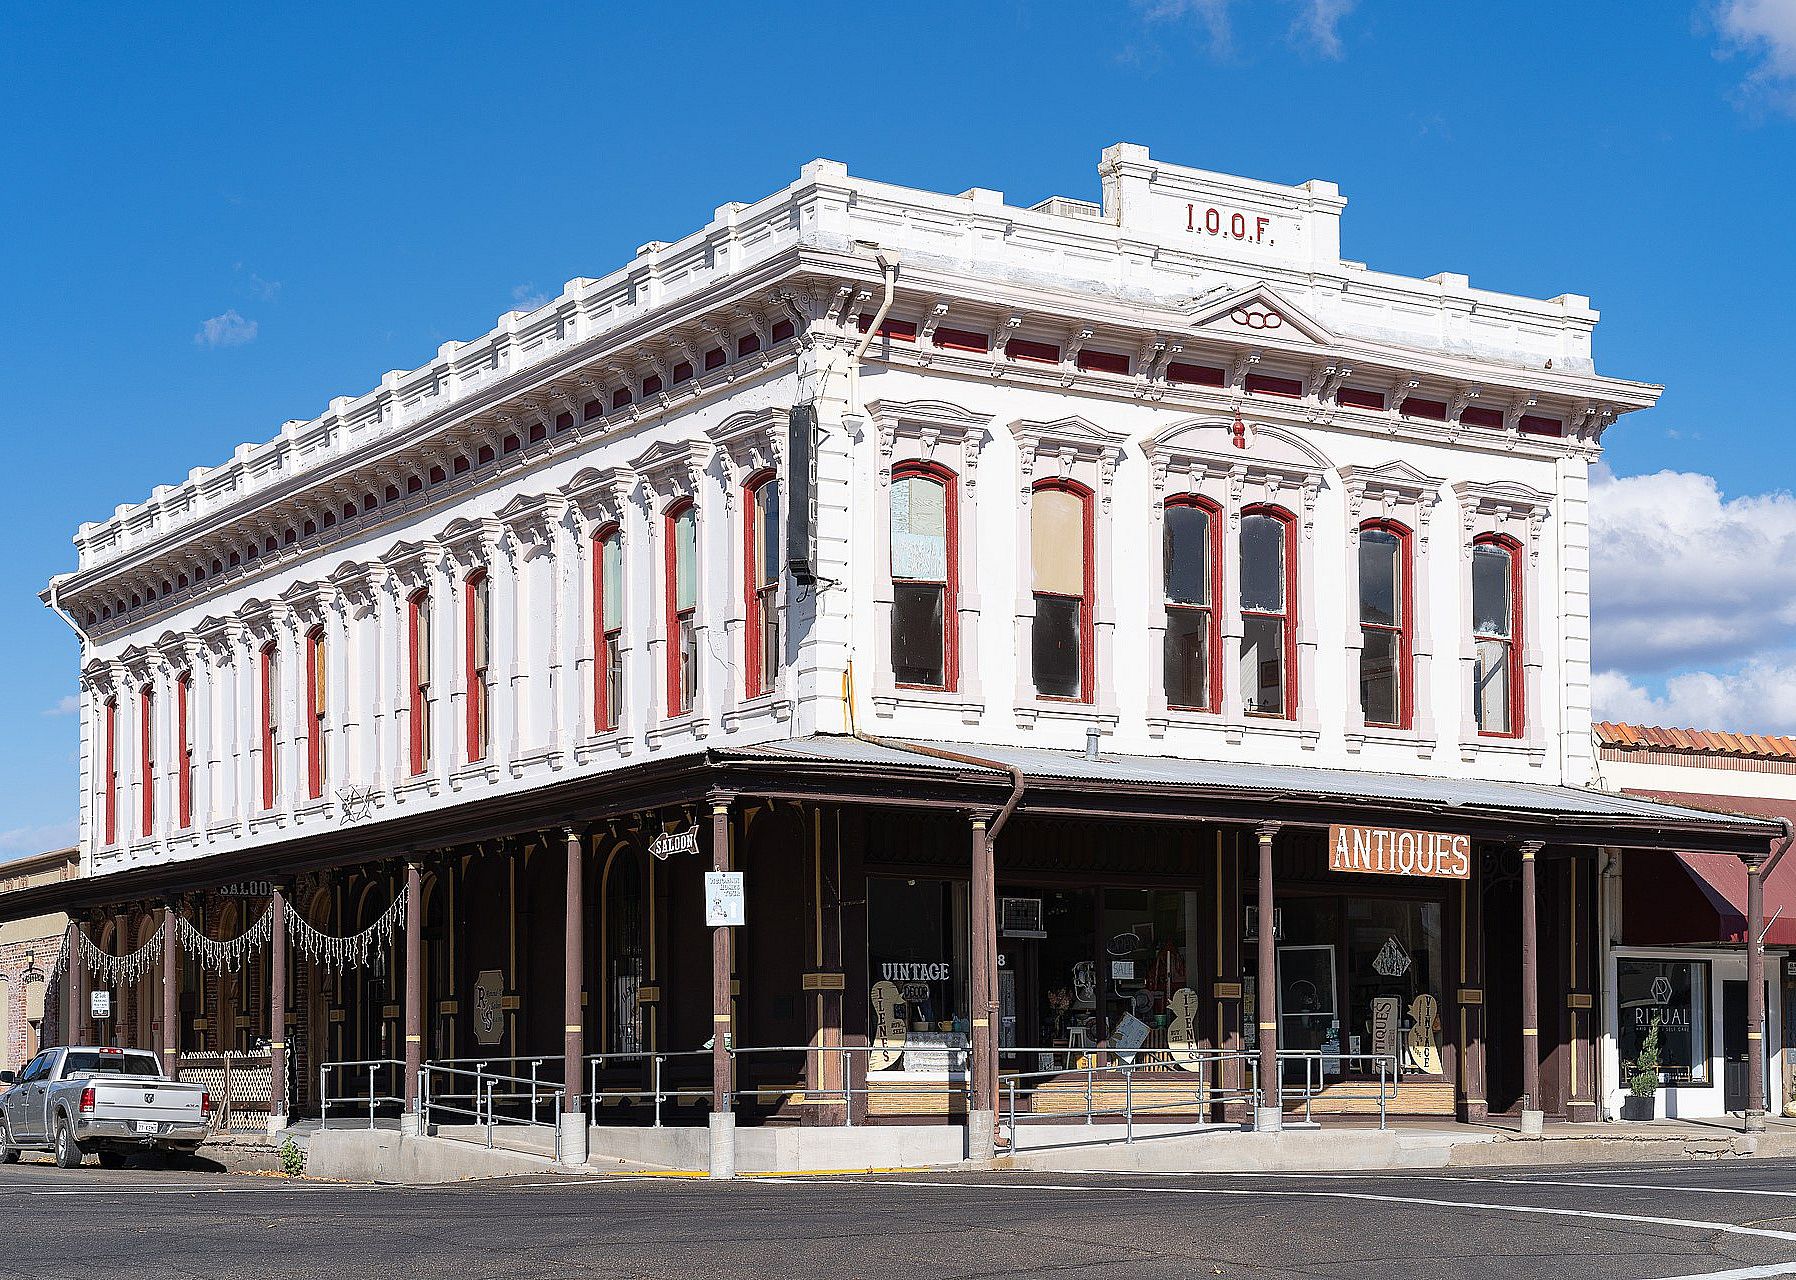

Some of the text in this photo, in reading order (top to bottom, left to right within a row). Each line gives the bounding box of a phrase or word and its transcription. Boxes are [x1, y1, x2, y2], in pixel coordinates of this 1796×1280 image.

[1185, 203, 1275, 246] I.O.O.F.
[655, 833, 694, 854] SALOON
[1333, 827, 1469, 876] ANTIQUES
[882, 963, 950, 981] VINTAGE
[1113, 962, 1134, 976] SALE
[904, 985, 928, 999] DECOR
[877, 987, 890, 1062] ILENES
[1183, 994, 1197, 1061] ILENES
[1424, 996, 1432, 1067] VINTAGE
[1635, 1007, 1690, 1025] RITUAL
